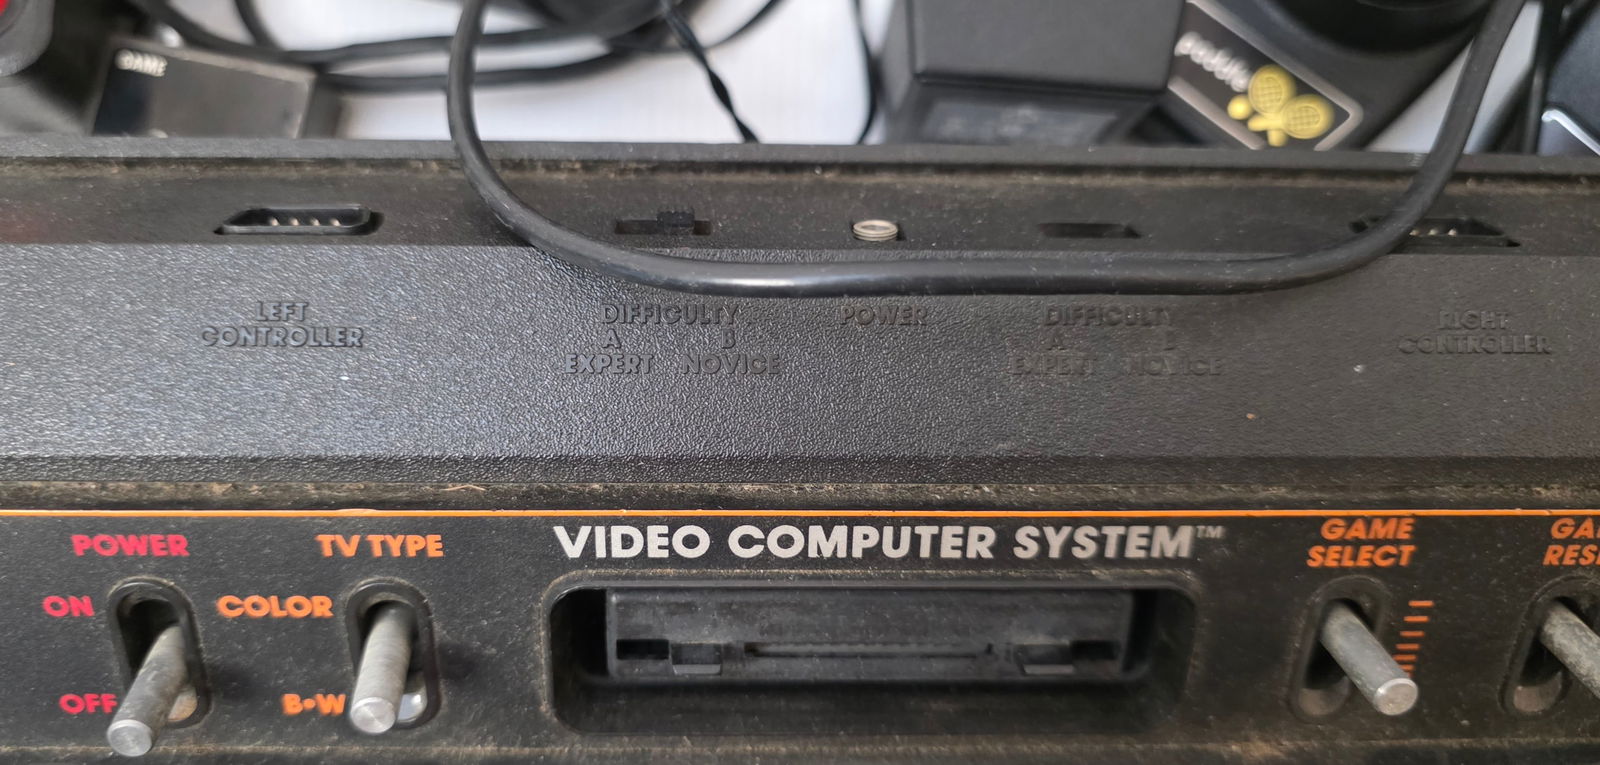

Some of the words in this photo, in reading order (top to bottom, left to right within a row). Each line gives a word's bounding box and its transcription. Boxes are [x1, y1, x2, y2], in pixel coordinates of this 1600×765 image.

[254, 301, 309, 322] LEFT
[601, 303, 738, 325] DIFFICULTY
[841, 304, 928, 326] POWER
[201, 326, 365, 348] CONTROLLER
[602, 328, 622, 349] A
[721, 327, 736, 349] B
[1400, 334, 1552, 354] CONTROLLER
[564, 353, 652, 375] EXPERT
[682, 353, 782, 375] NOVICE
[1320, 517, 1416, 541] GAME
[1551, 517, 1600, 540] GA
[71, 534, 189, 558] POWER
[315, 534, 361, 558] TV
[366, 534, 444, 558] TYPE
[553, 525, 709, 559] VIDEO
[727, 525, 995, 560] COMPUTER
[1306, 545, 1417, 568] SELECT
[42, 595, 94, 617] ON
[216, 595, 333, 619] COLOR
[59, 693, 118, 715] OFF
